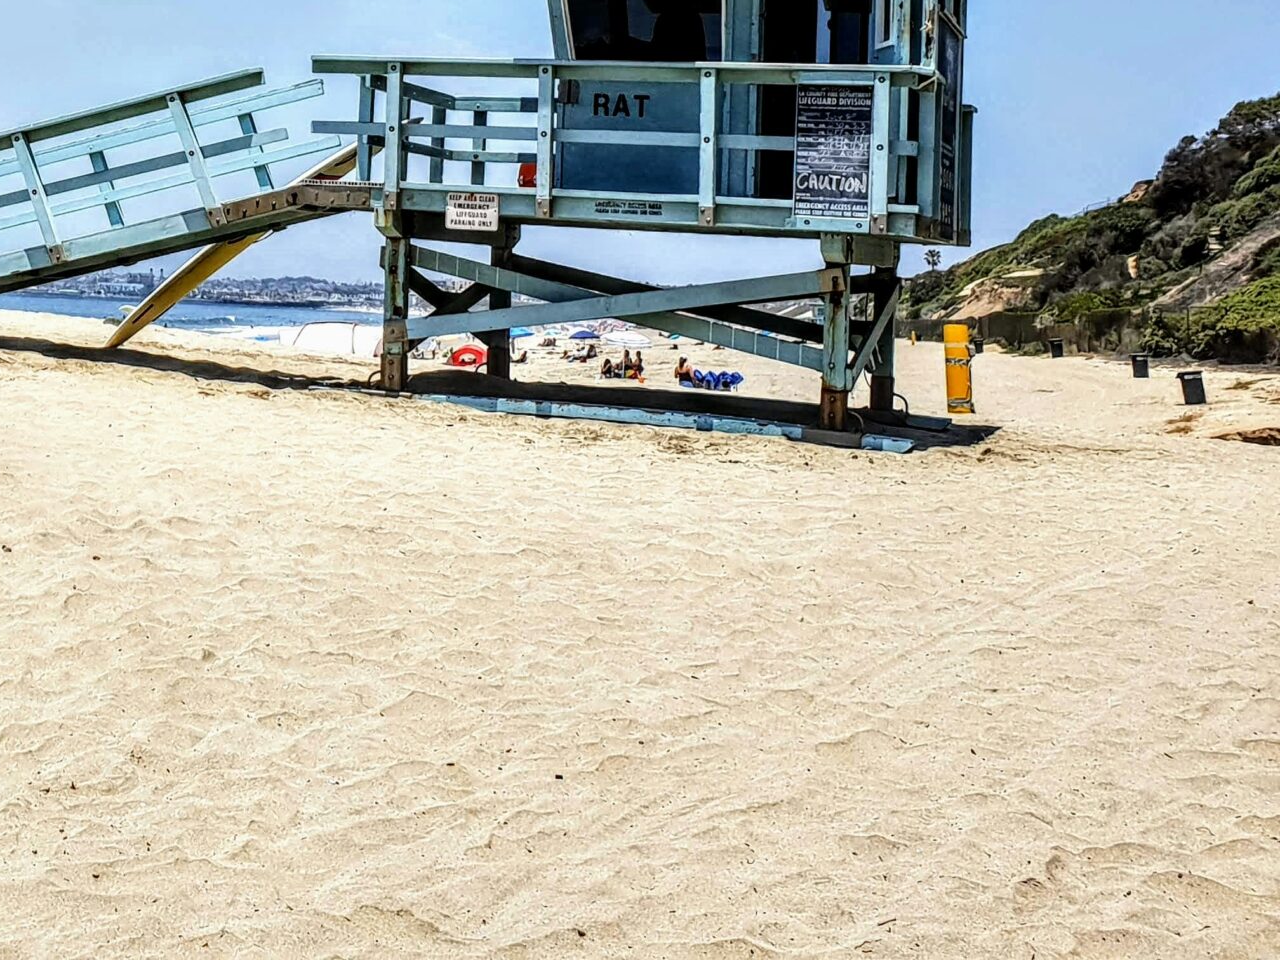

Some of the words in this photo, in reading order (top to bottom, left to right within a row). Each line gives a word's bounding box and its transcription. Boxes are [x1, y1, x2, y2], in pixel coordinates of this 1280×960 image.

[593, 92, 651, 118] RAT
[798, 97, 837, 105] LIFEGUARD
[839, 97, 871, 106] DIVISION
[463, 194, 477, 202] AREA
[478, 195, 495, 203] CLEAR
[453, 202, 490, 210] EMERGENCY
[795, 201, 830, 210] EMERGENCY
[830, 203, 852, 211] ACCESS
[455, 211, 488, 219] LIFEGUARD
